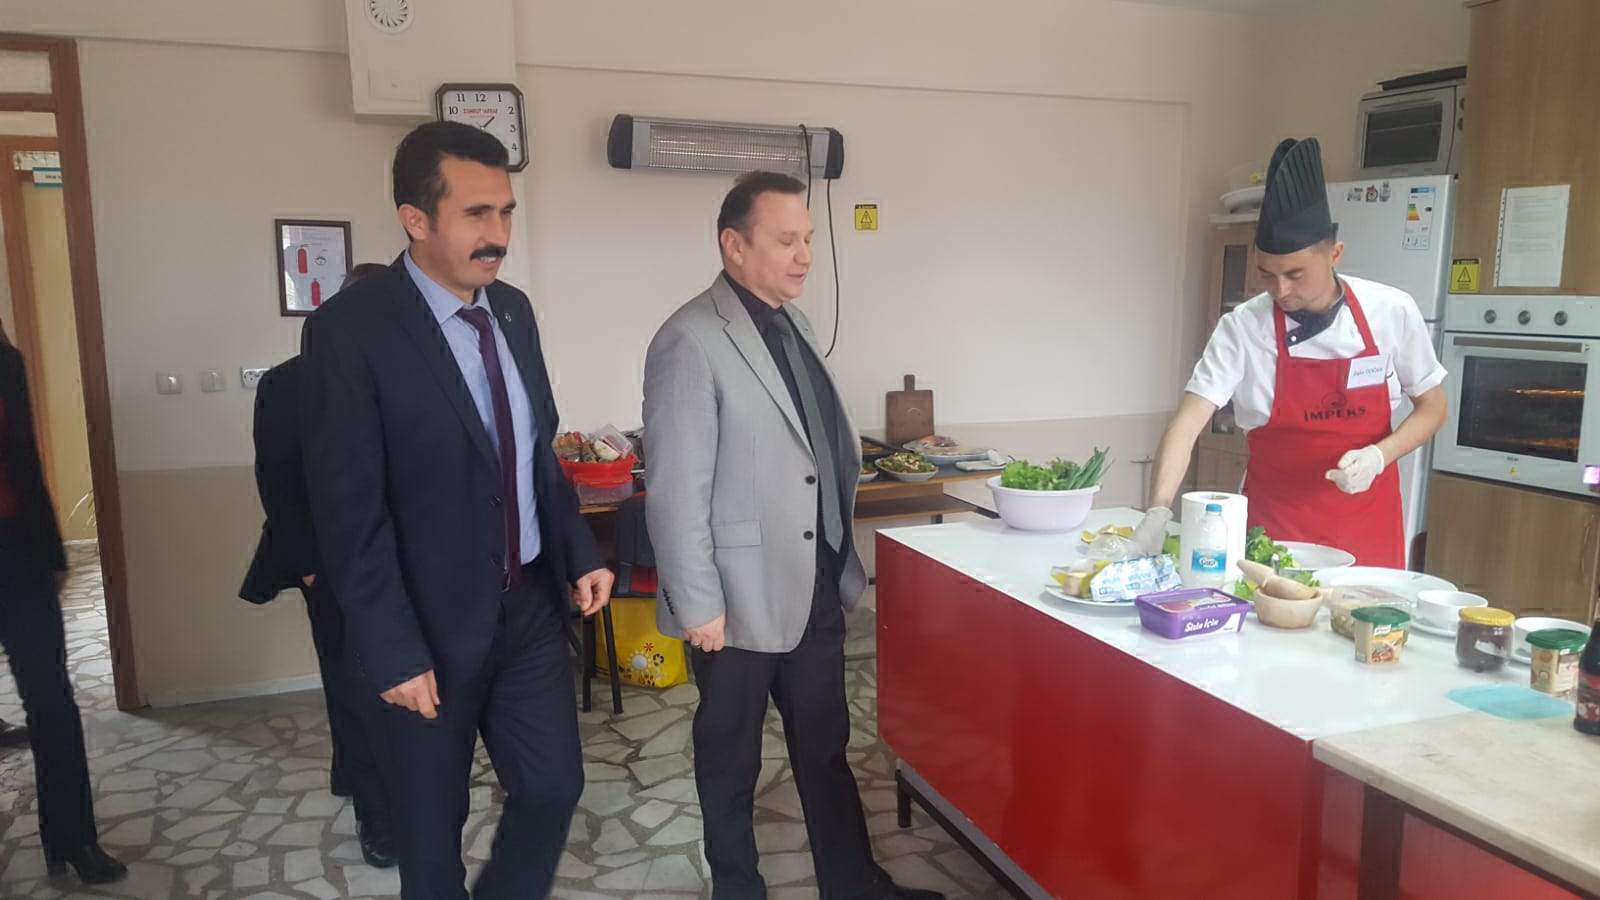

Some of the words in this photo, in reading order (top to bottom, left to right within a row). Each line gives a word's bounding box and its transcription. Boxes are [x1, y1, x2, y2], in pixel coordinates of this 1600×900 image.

[457, 93, 465, 102] 11
[475, 93, 487, 102] 12
[498, 93, 502, 102] 1
[448, 105, 459, 115] 10
[508, 106, 514, 114] 2
[510, 124, 516, 133] 3
[511, 144, 520, 152] 4
